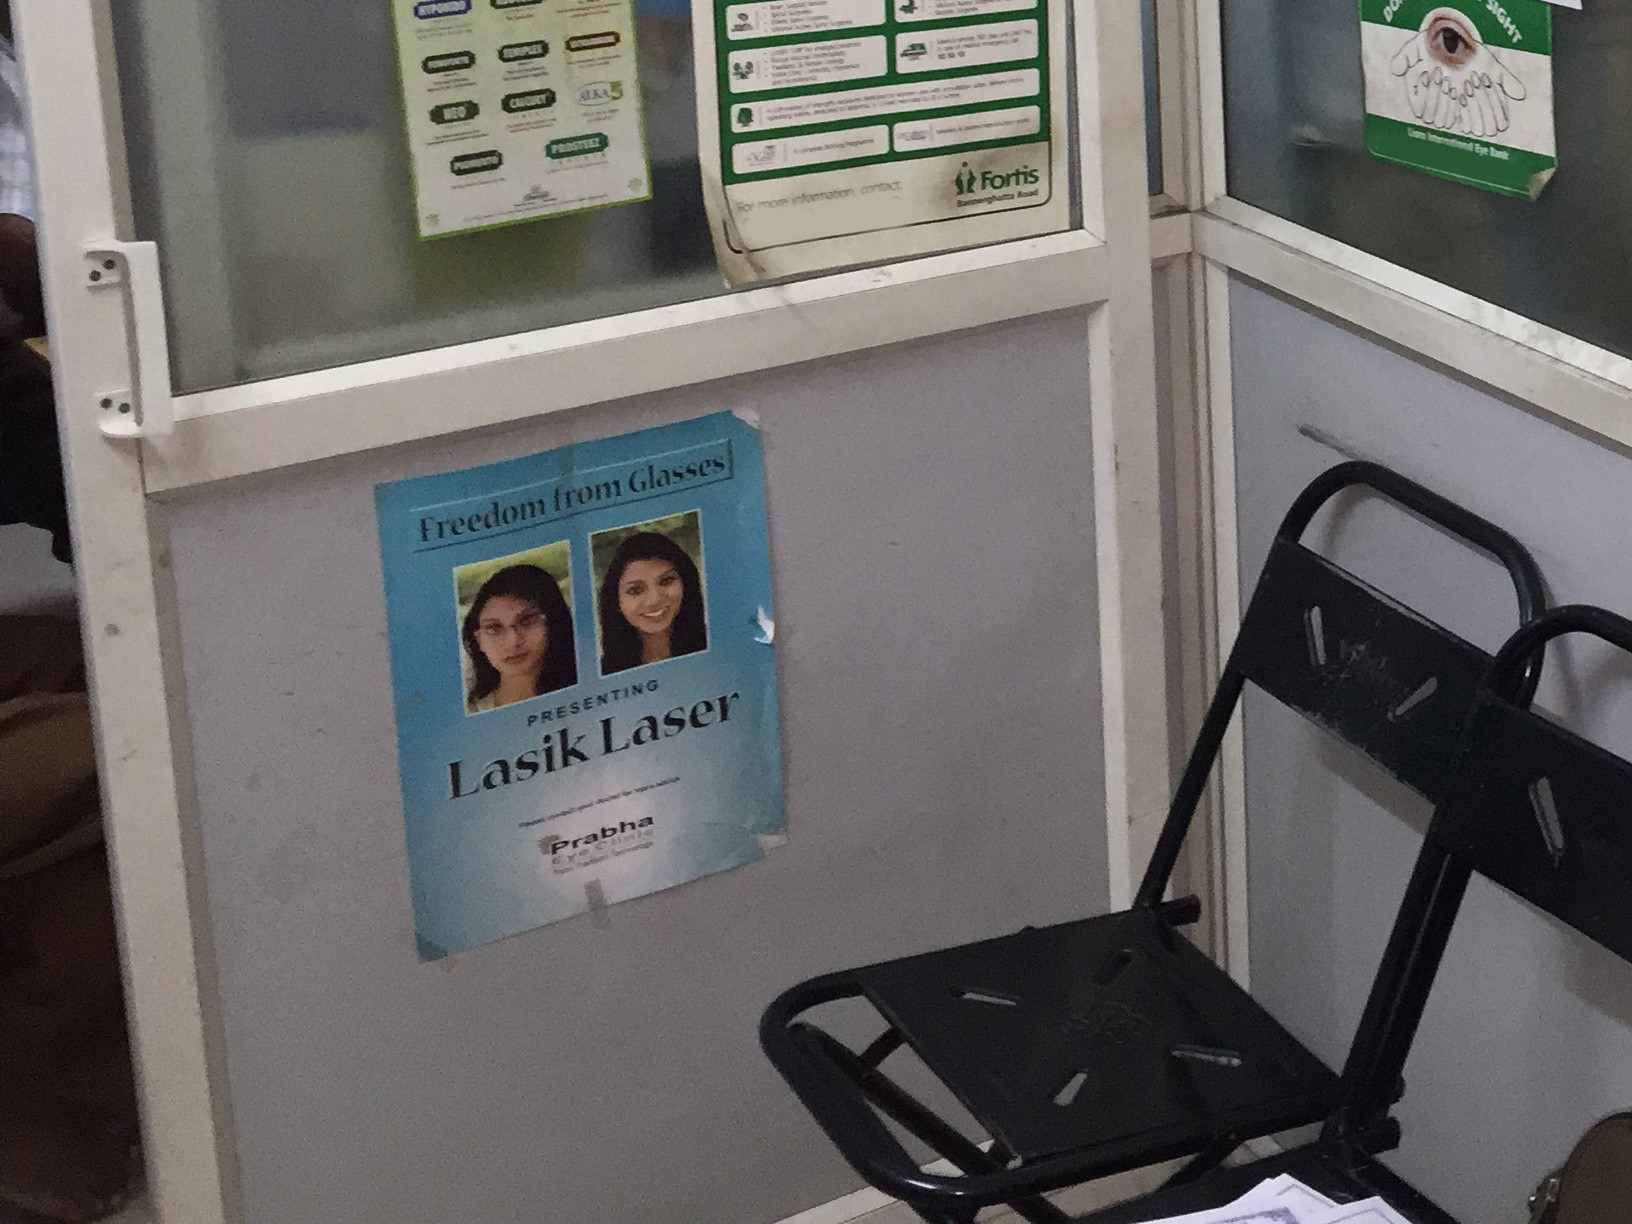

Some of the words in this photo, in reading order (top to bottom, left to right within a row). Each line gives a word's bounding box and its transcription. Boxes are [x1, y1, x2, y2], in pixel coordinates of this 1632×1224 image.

[980, 165, 1040, 191] Fortis
[419, 498, 547, 543] Freedom
[554, 478, 623, 512] from
[628, 454, 728, 495] Glasses
[527, 679, 661, 727] PRESENTING
[448, 728, 588, 801] Lasik
[600, 691, 741, 756] Laser
[551, 815, 654, 856] Prabha
